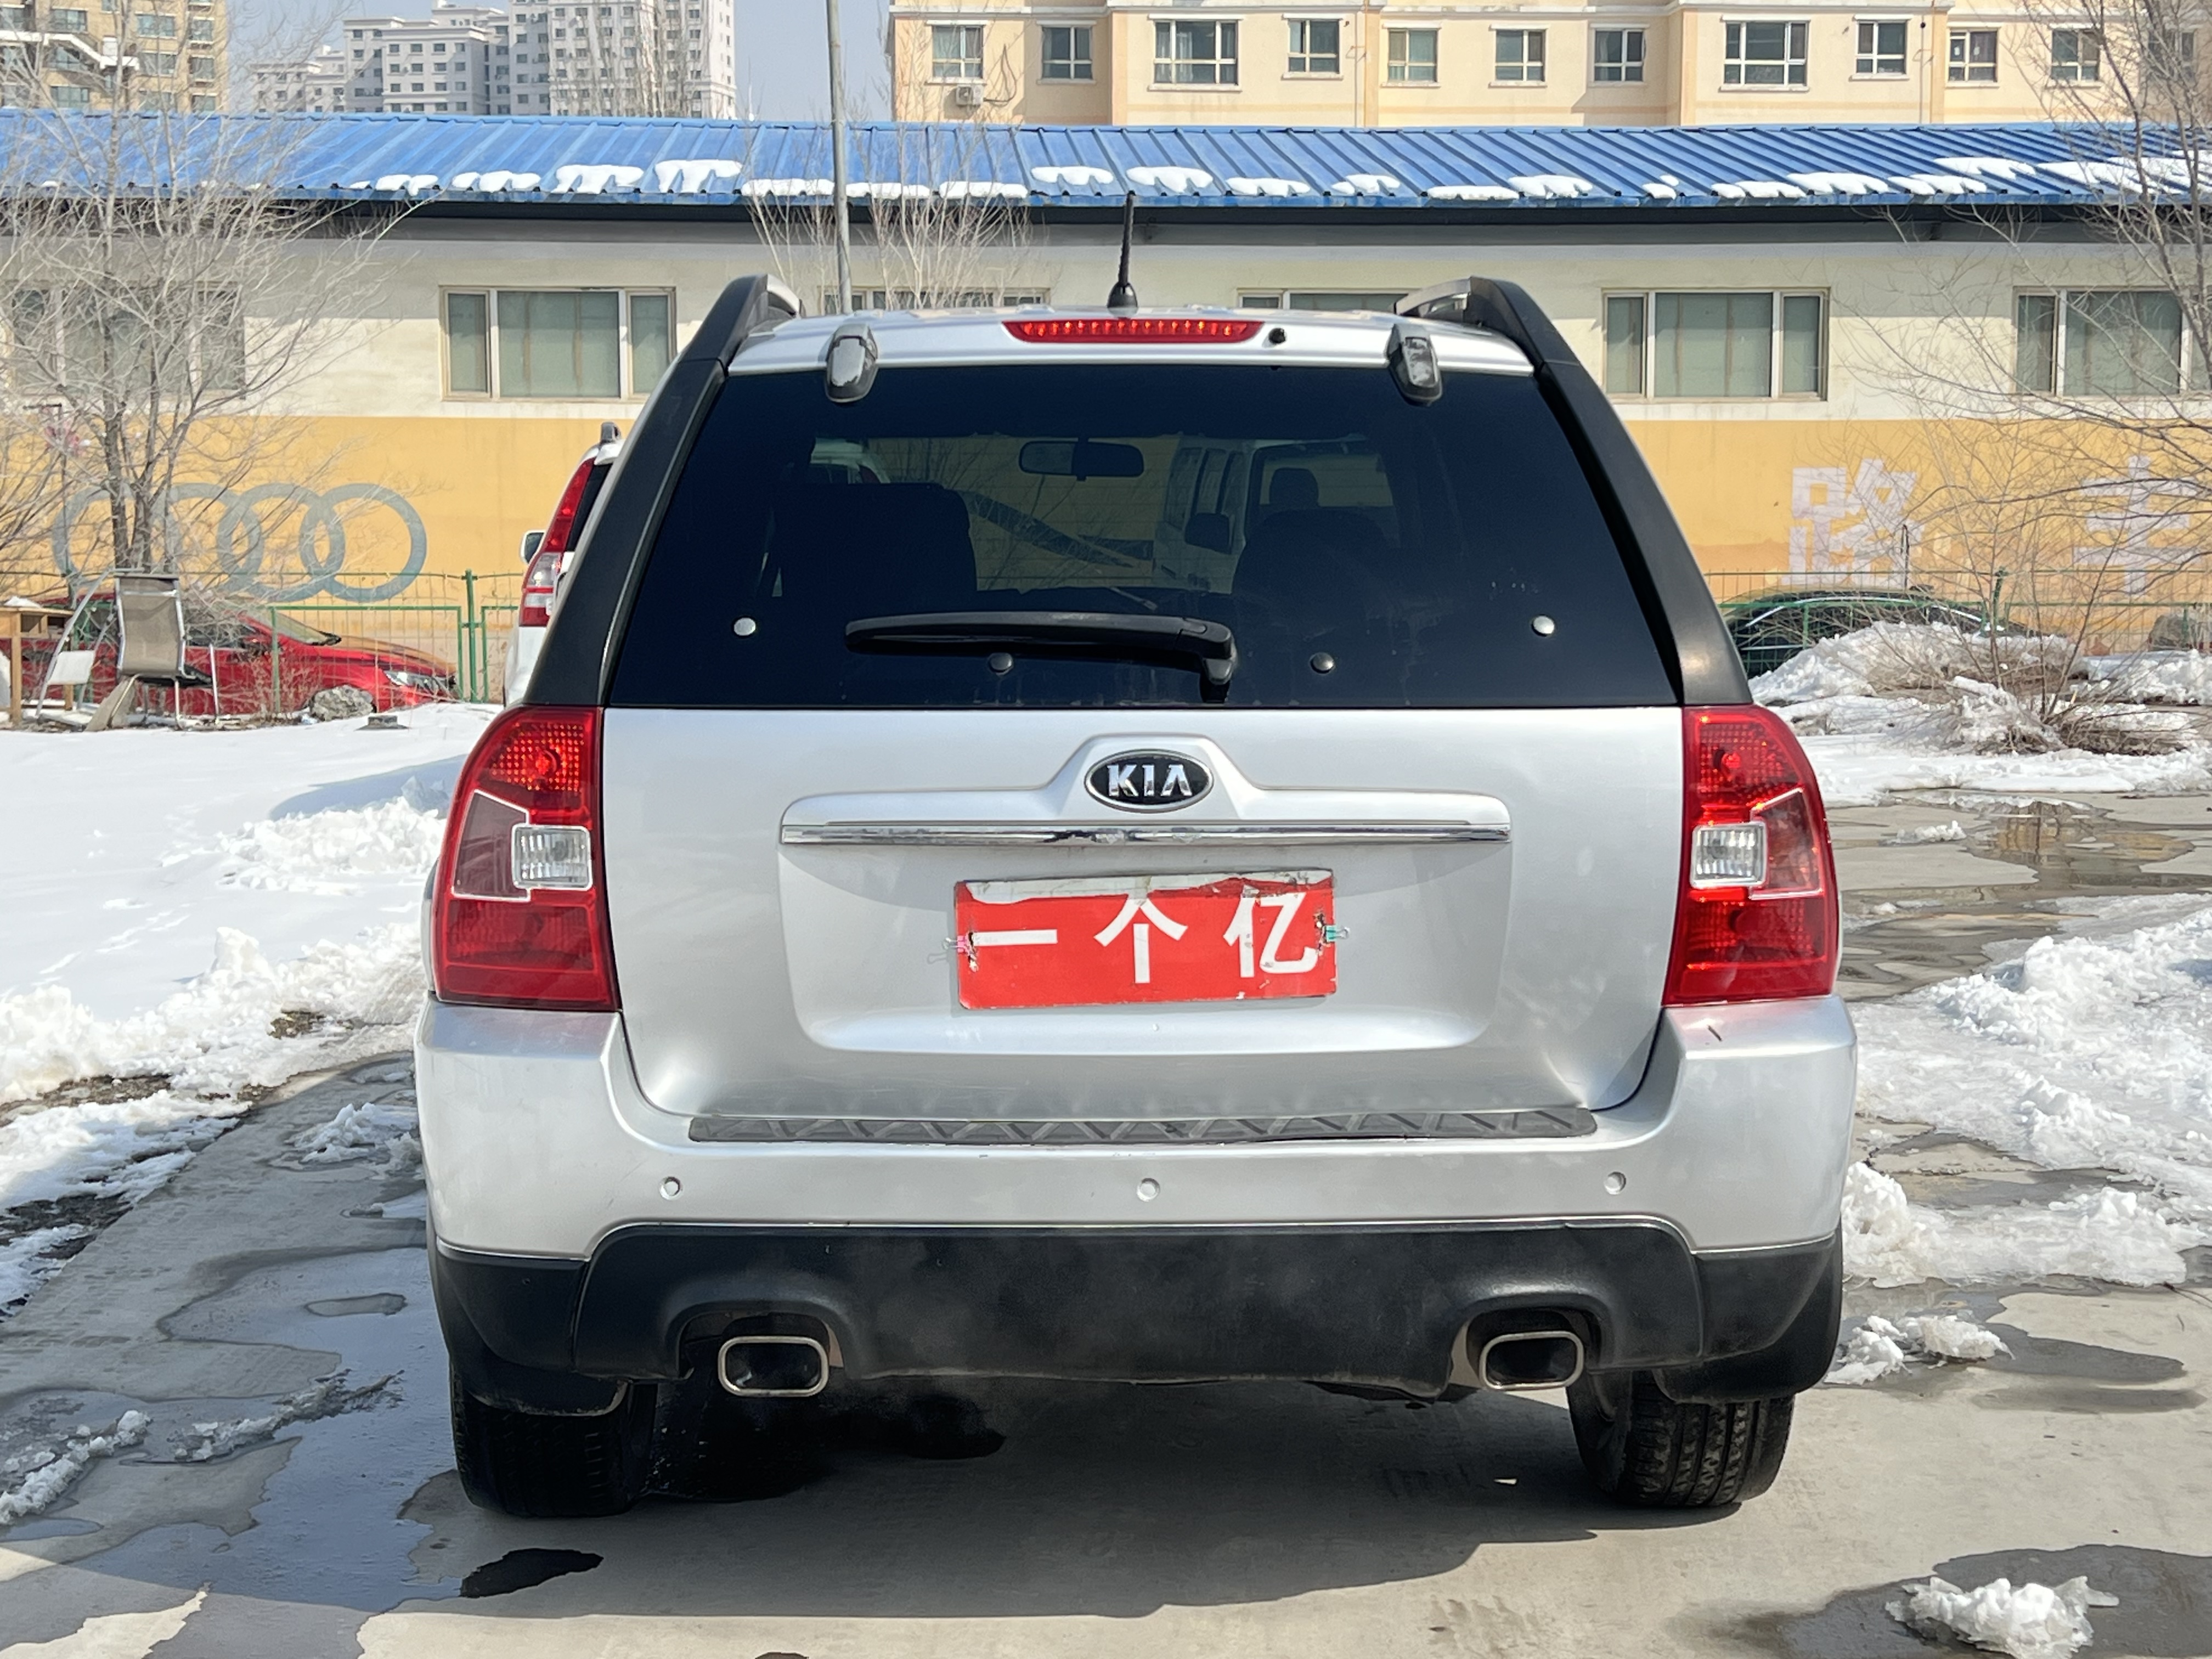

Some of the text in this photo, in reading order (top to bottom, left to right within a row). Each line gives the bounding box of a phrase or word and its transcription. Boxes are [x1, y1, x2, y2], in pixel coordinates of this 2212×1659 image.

[1107, 764, 1192, 796] KIA
[971, 884, 1317, 983] 一个亿
